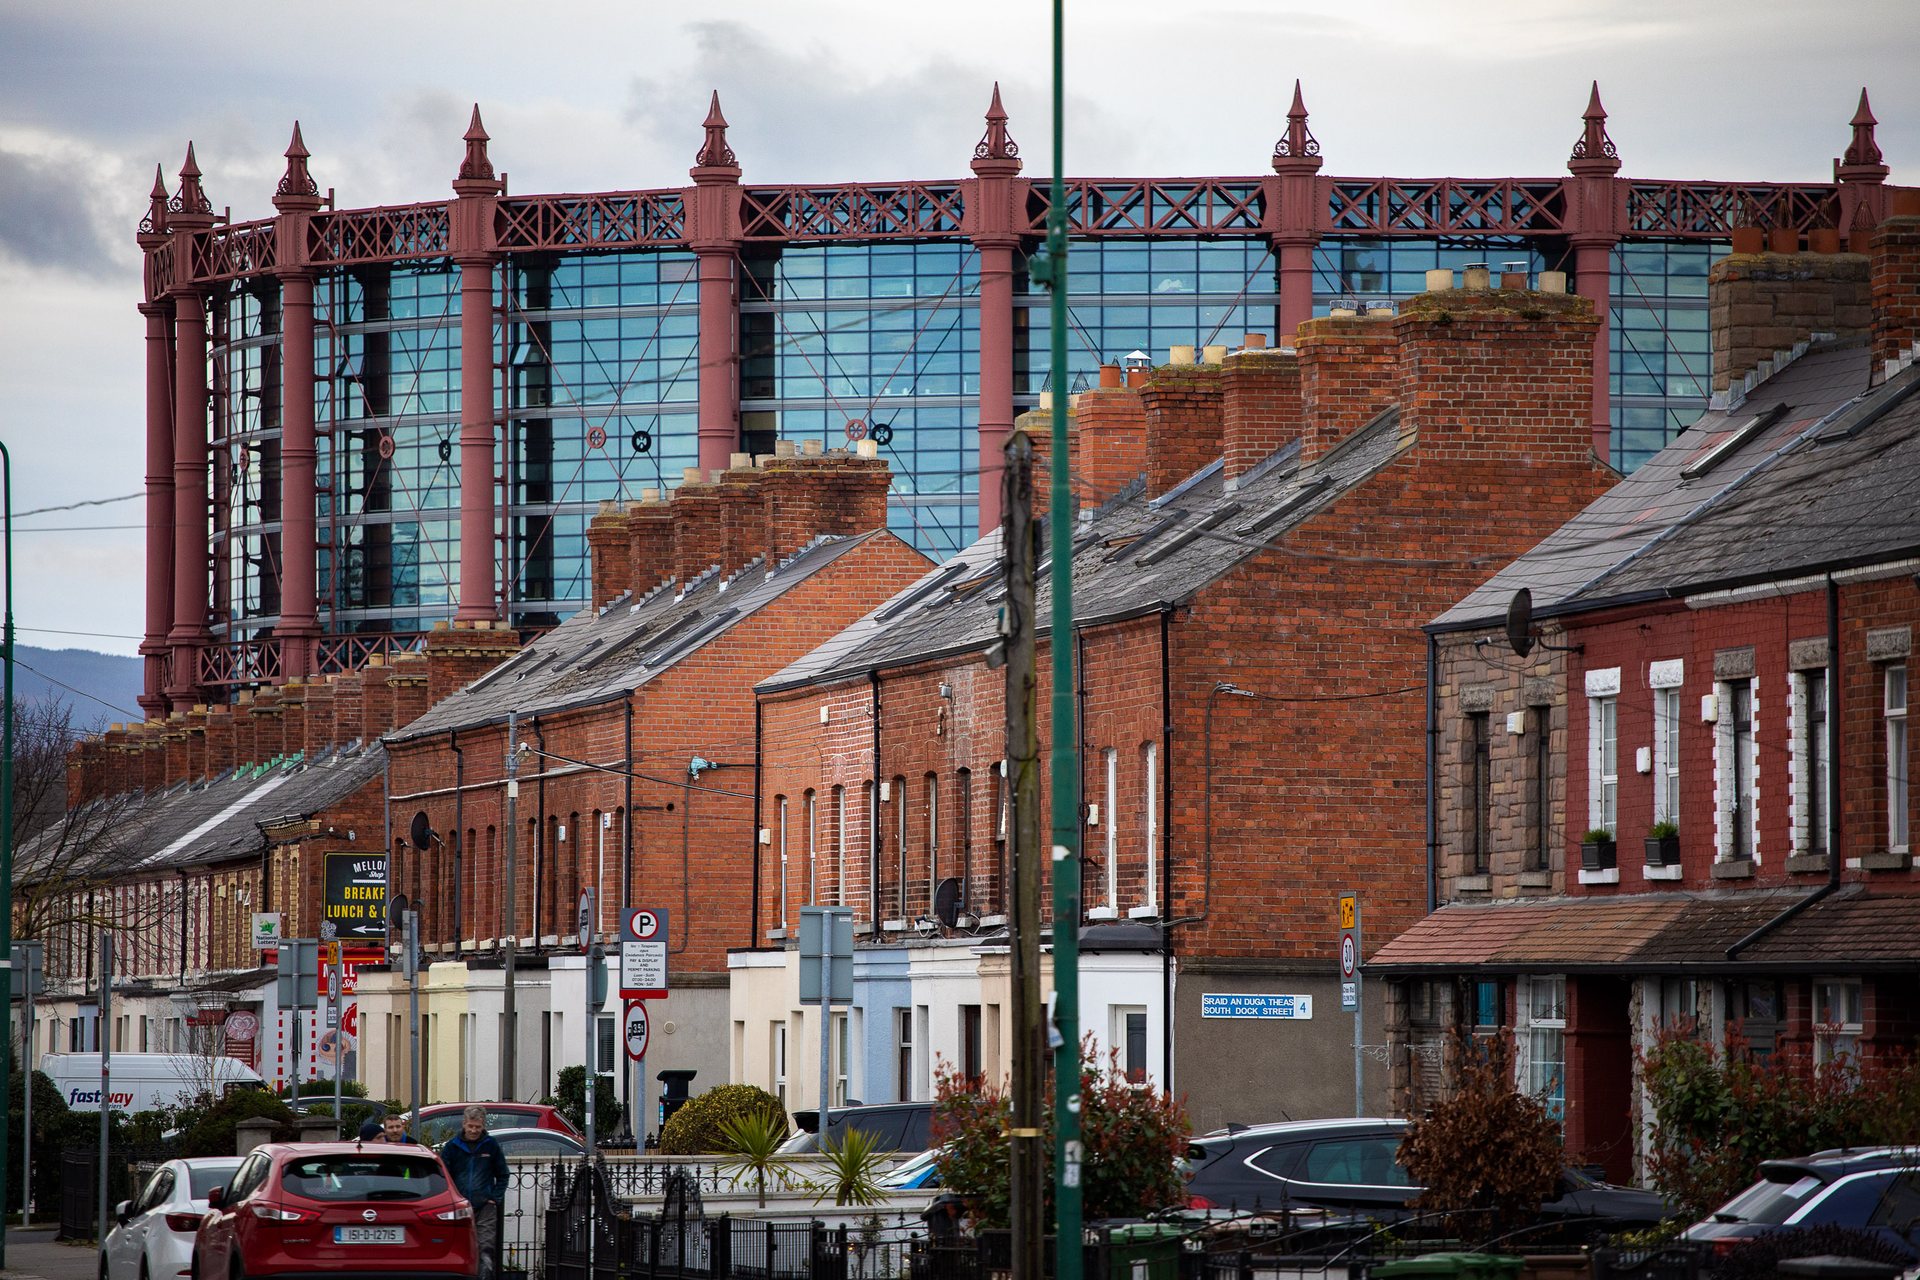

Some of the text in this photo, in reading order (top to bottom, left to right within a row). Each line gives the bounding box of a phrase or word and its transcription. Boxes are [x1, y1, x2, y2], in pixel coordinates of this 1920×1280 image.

[353, 860, 387, 873] MELLO
[327, 905, 363, 918] LUNCH
[369, 905, 377, 918] &
[1344, 944, 1352, 962] 30
[1244, 998, 1266, 1006] DUGA
[1269, 998, 1294, 1006] THEAS
[1300, 1002, 1306, 1013] 4
[1235, 1007, 1258, 1015] DOCK
